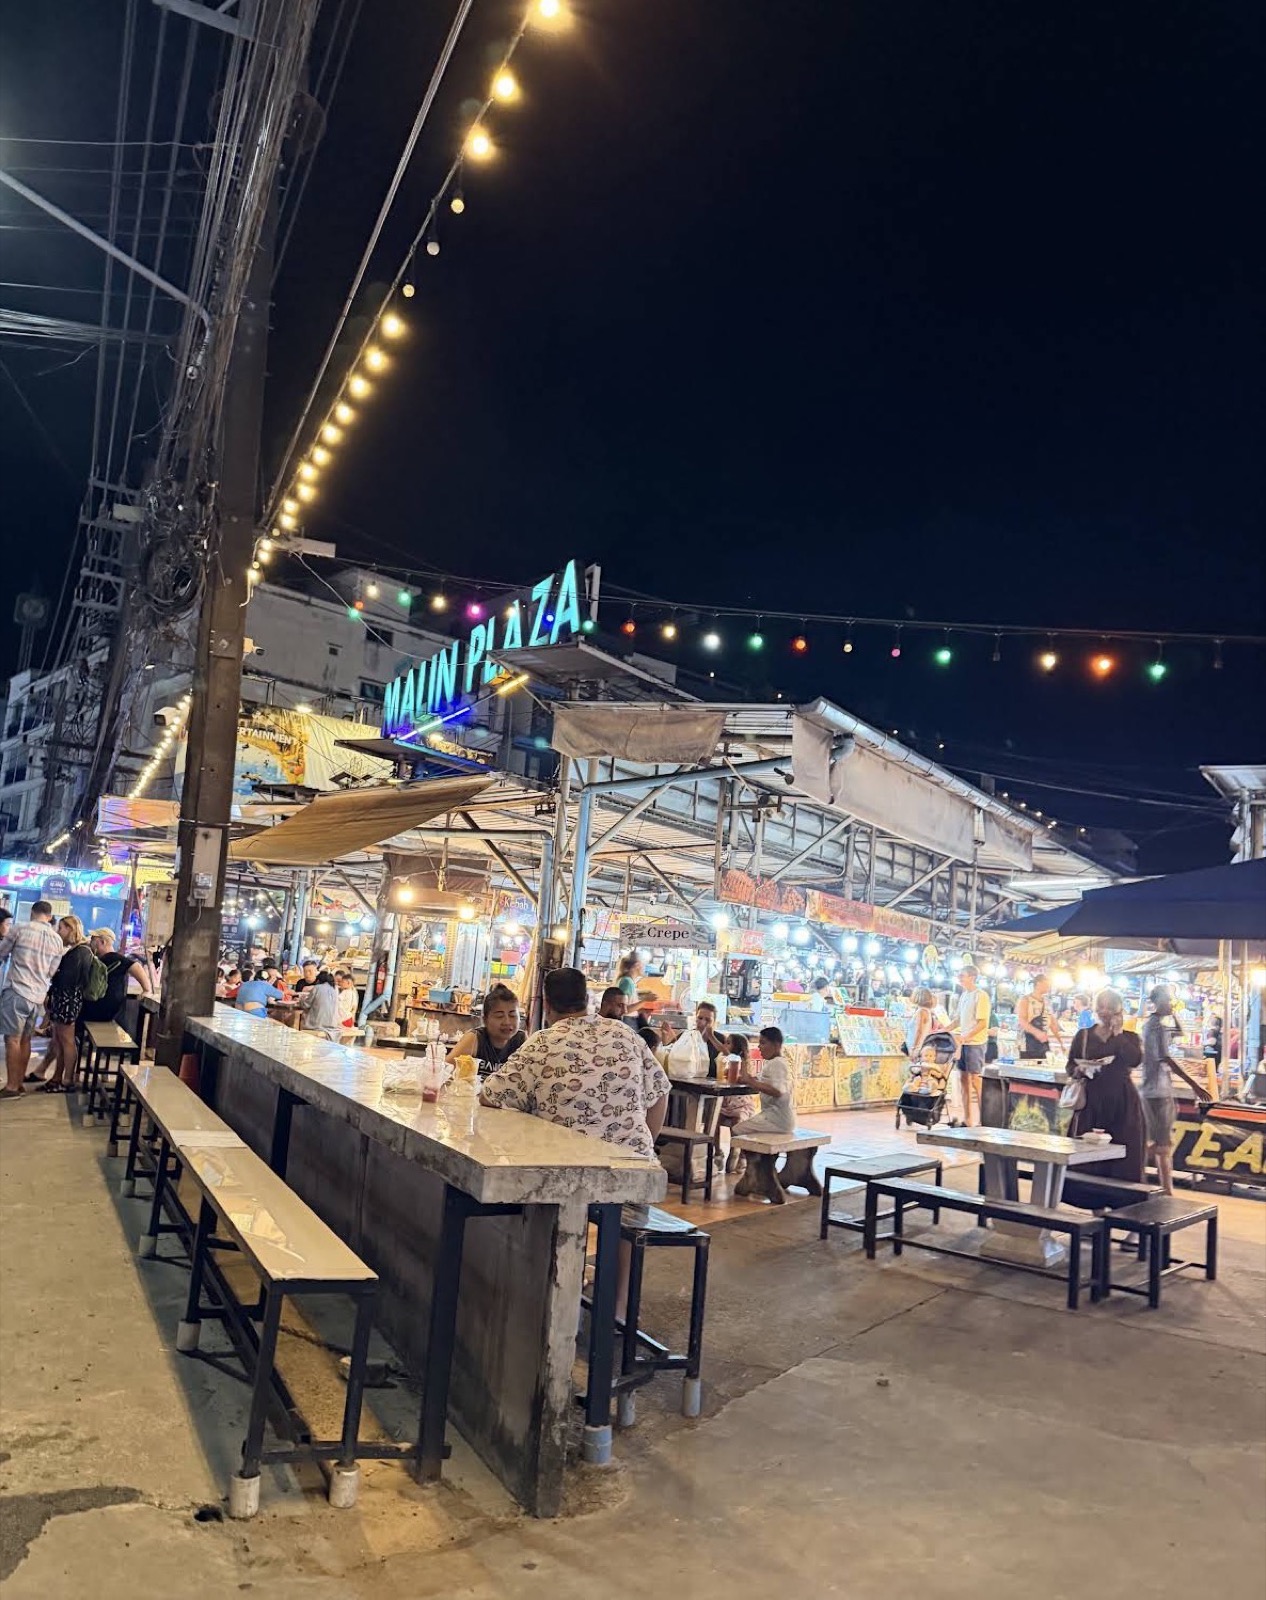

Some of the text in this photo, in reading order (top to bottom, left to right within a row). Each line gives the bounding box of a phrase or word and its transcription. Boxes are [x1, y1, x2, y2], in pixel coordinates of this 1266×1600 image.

[381, 559, 580, 738] MALIN PLAZA
[237, 726, 296, 746] ERTAINMENT
[8, 863, 113, 896] EXANGE
[28, 865, 82, 878] CURRENCY
[647, 927, 690, 940] Crepe
[1171, 1121, 1266, 1174] TEA
